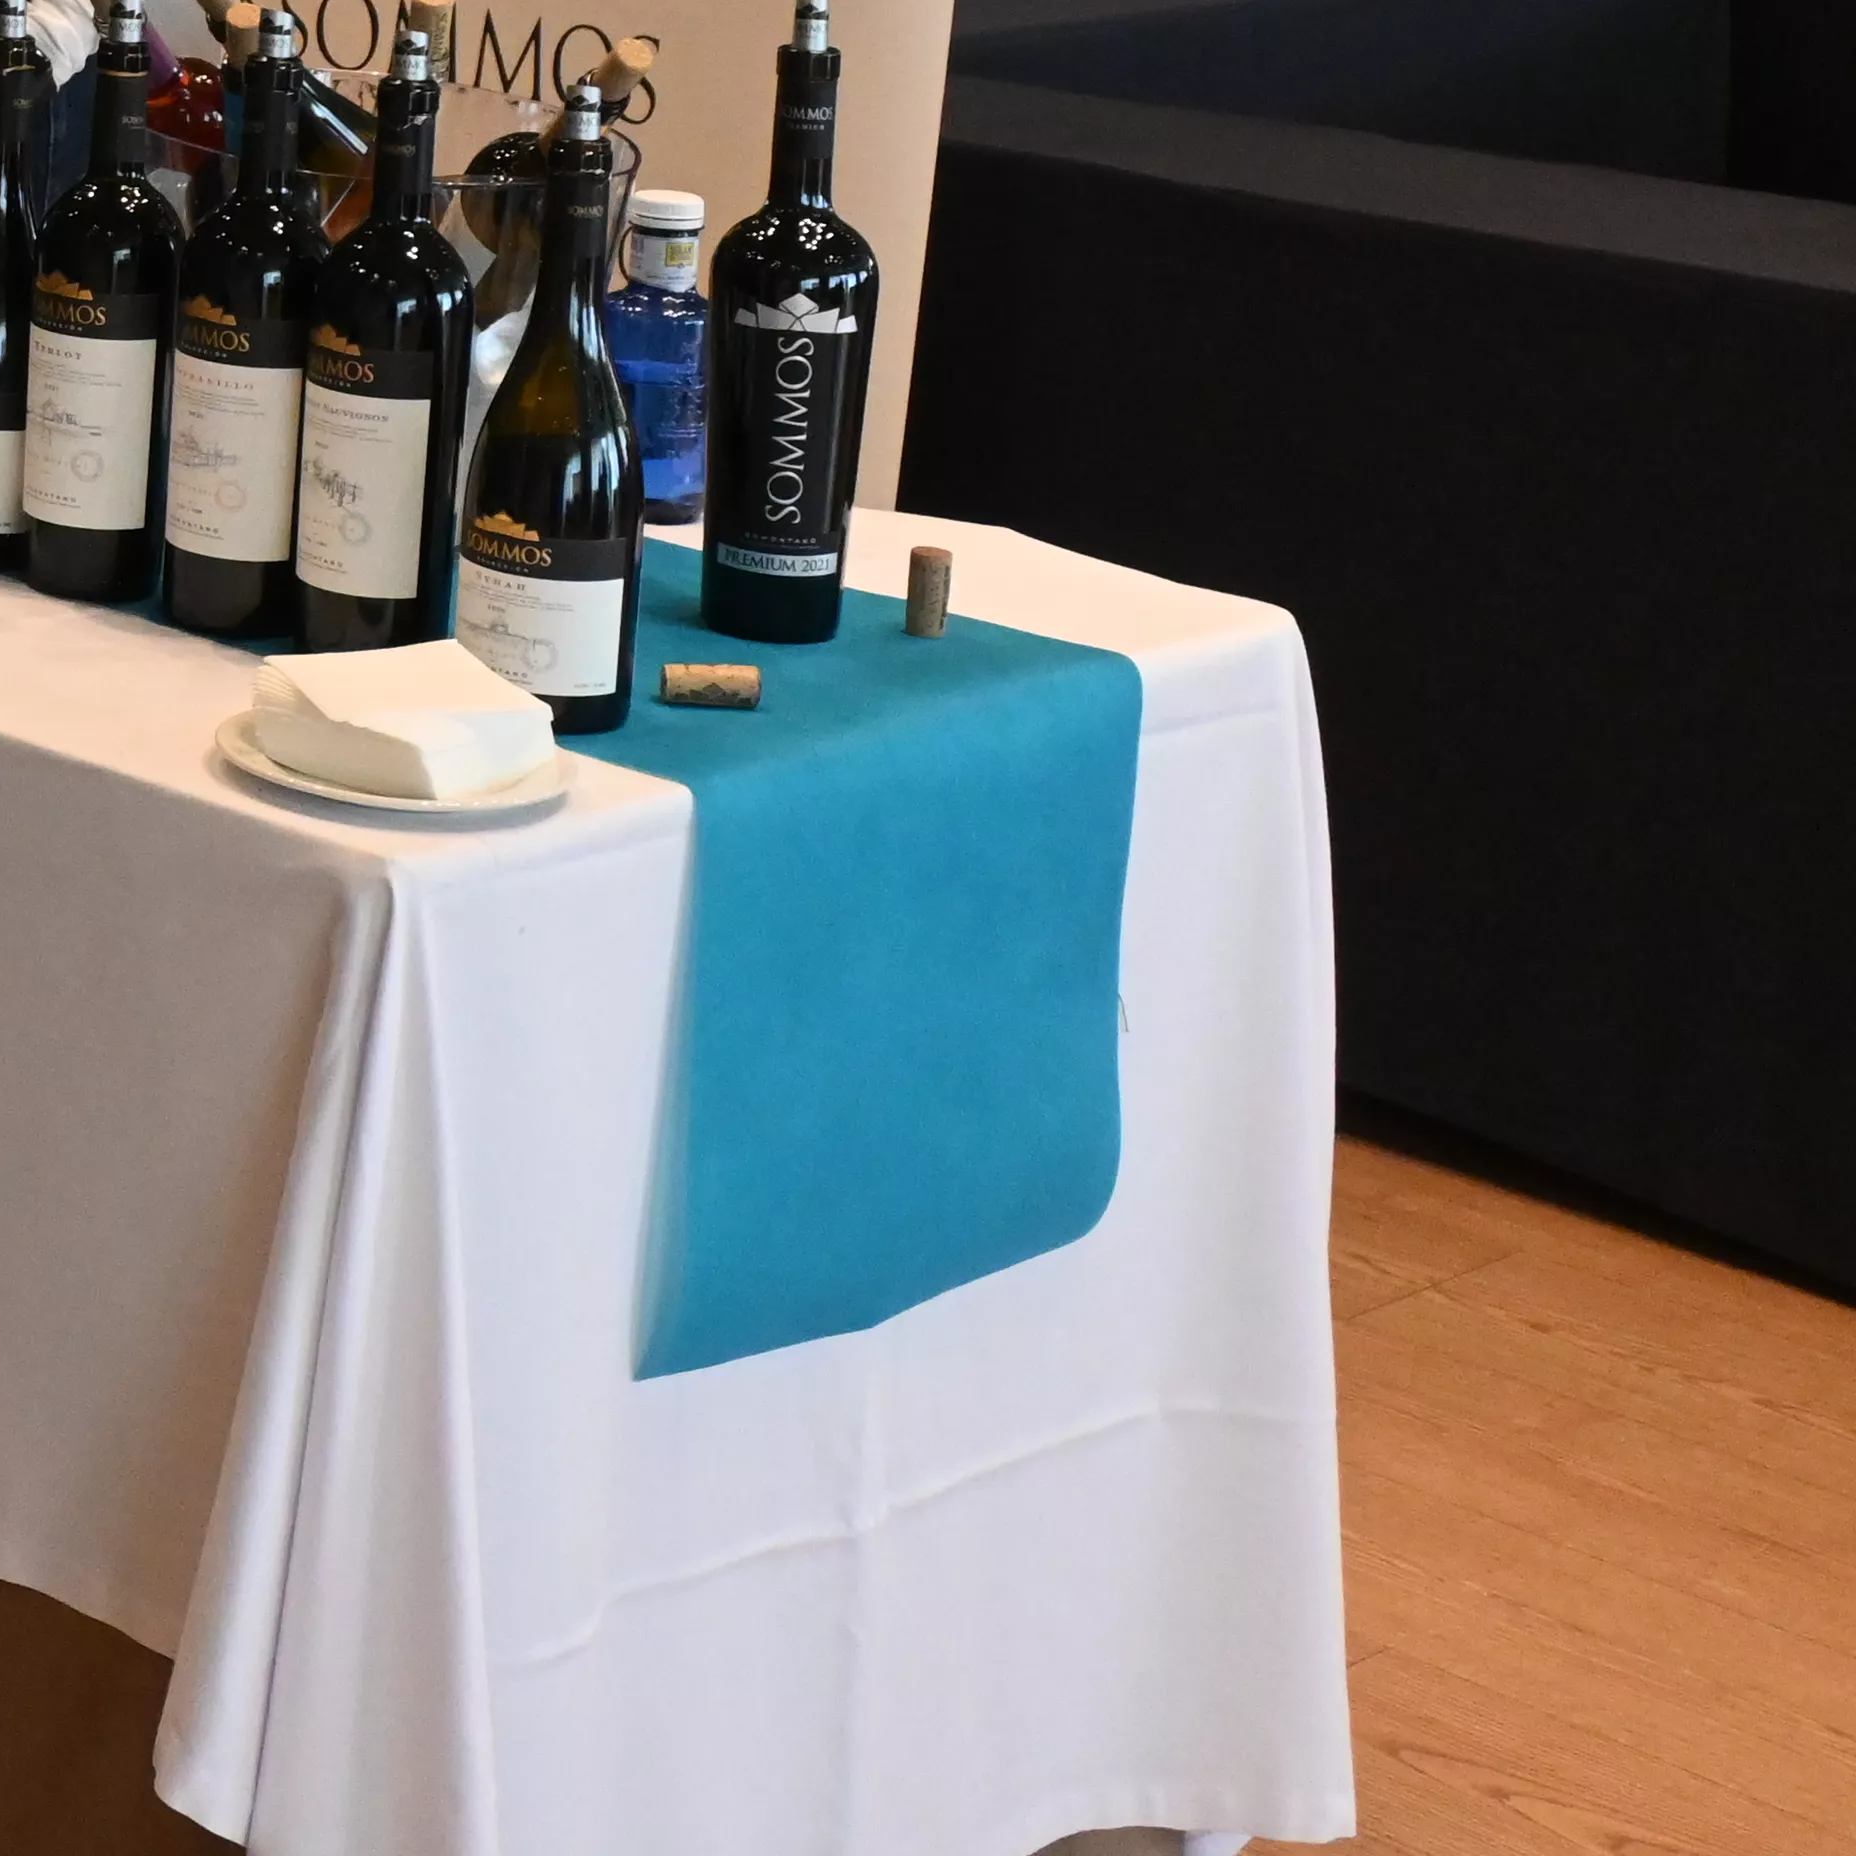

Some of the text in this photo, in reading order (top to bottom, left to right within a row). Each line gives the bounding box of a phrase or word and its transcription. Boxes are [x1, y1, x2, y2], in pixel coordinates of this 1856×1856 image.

[782, 105, 834, 122] OMMOS
[764, 336, 815, 525] SOMMOS
[466, 529, 553, 568] SOMMOS
[724, 547, 831, 573] PREMIUM 2021
[474, 570, 527, 592] SYRAH
